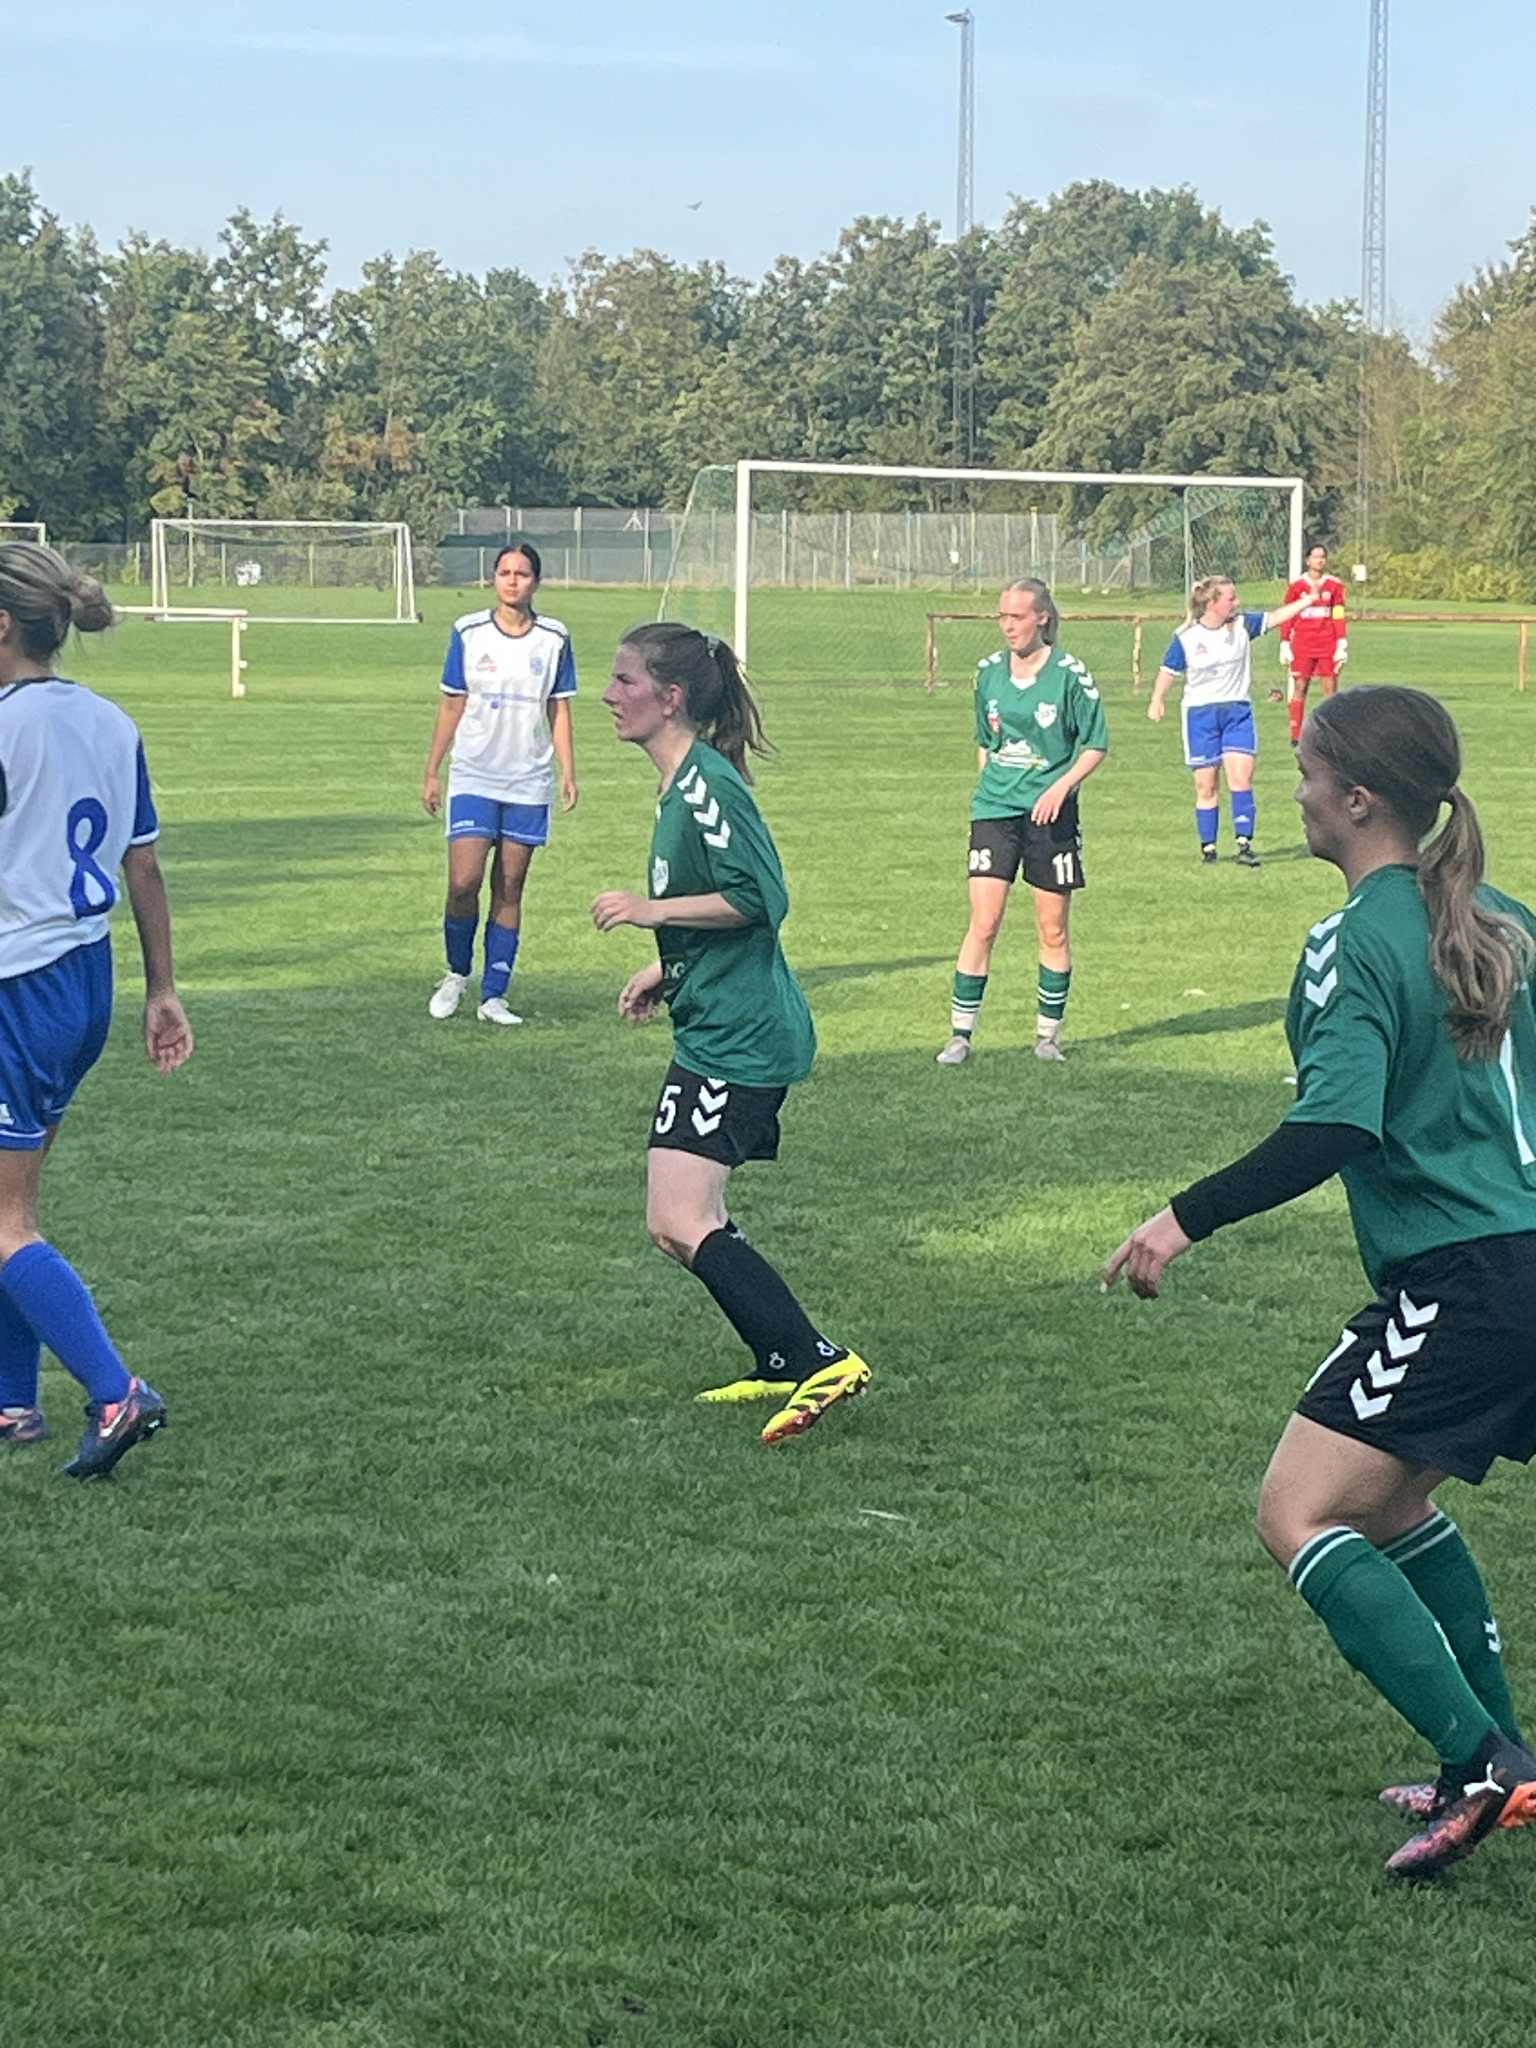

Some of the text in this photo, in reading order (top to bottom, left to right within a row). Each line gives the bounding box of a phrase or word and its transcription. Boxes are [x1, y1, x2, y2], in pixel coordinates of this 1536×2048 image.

[66, 797, 115, 920] 8
[1052, 852, 1074, 885] 11
[655, 1084, 682, 1134] 5
